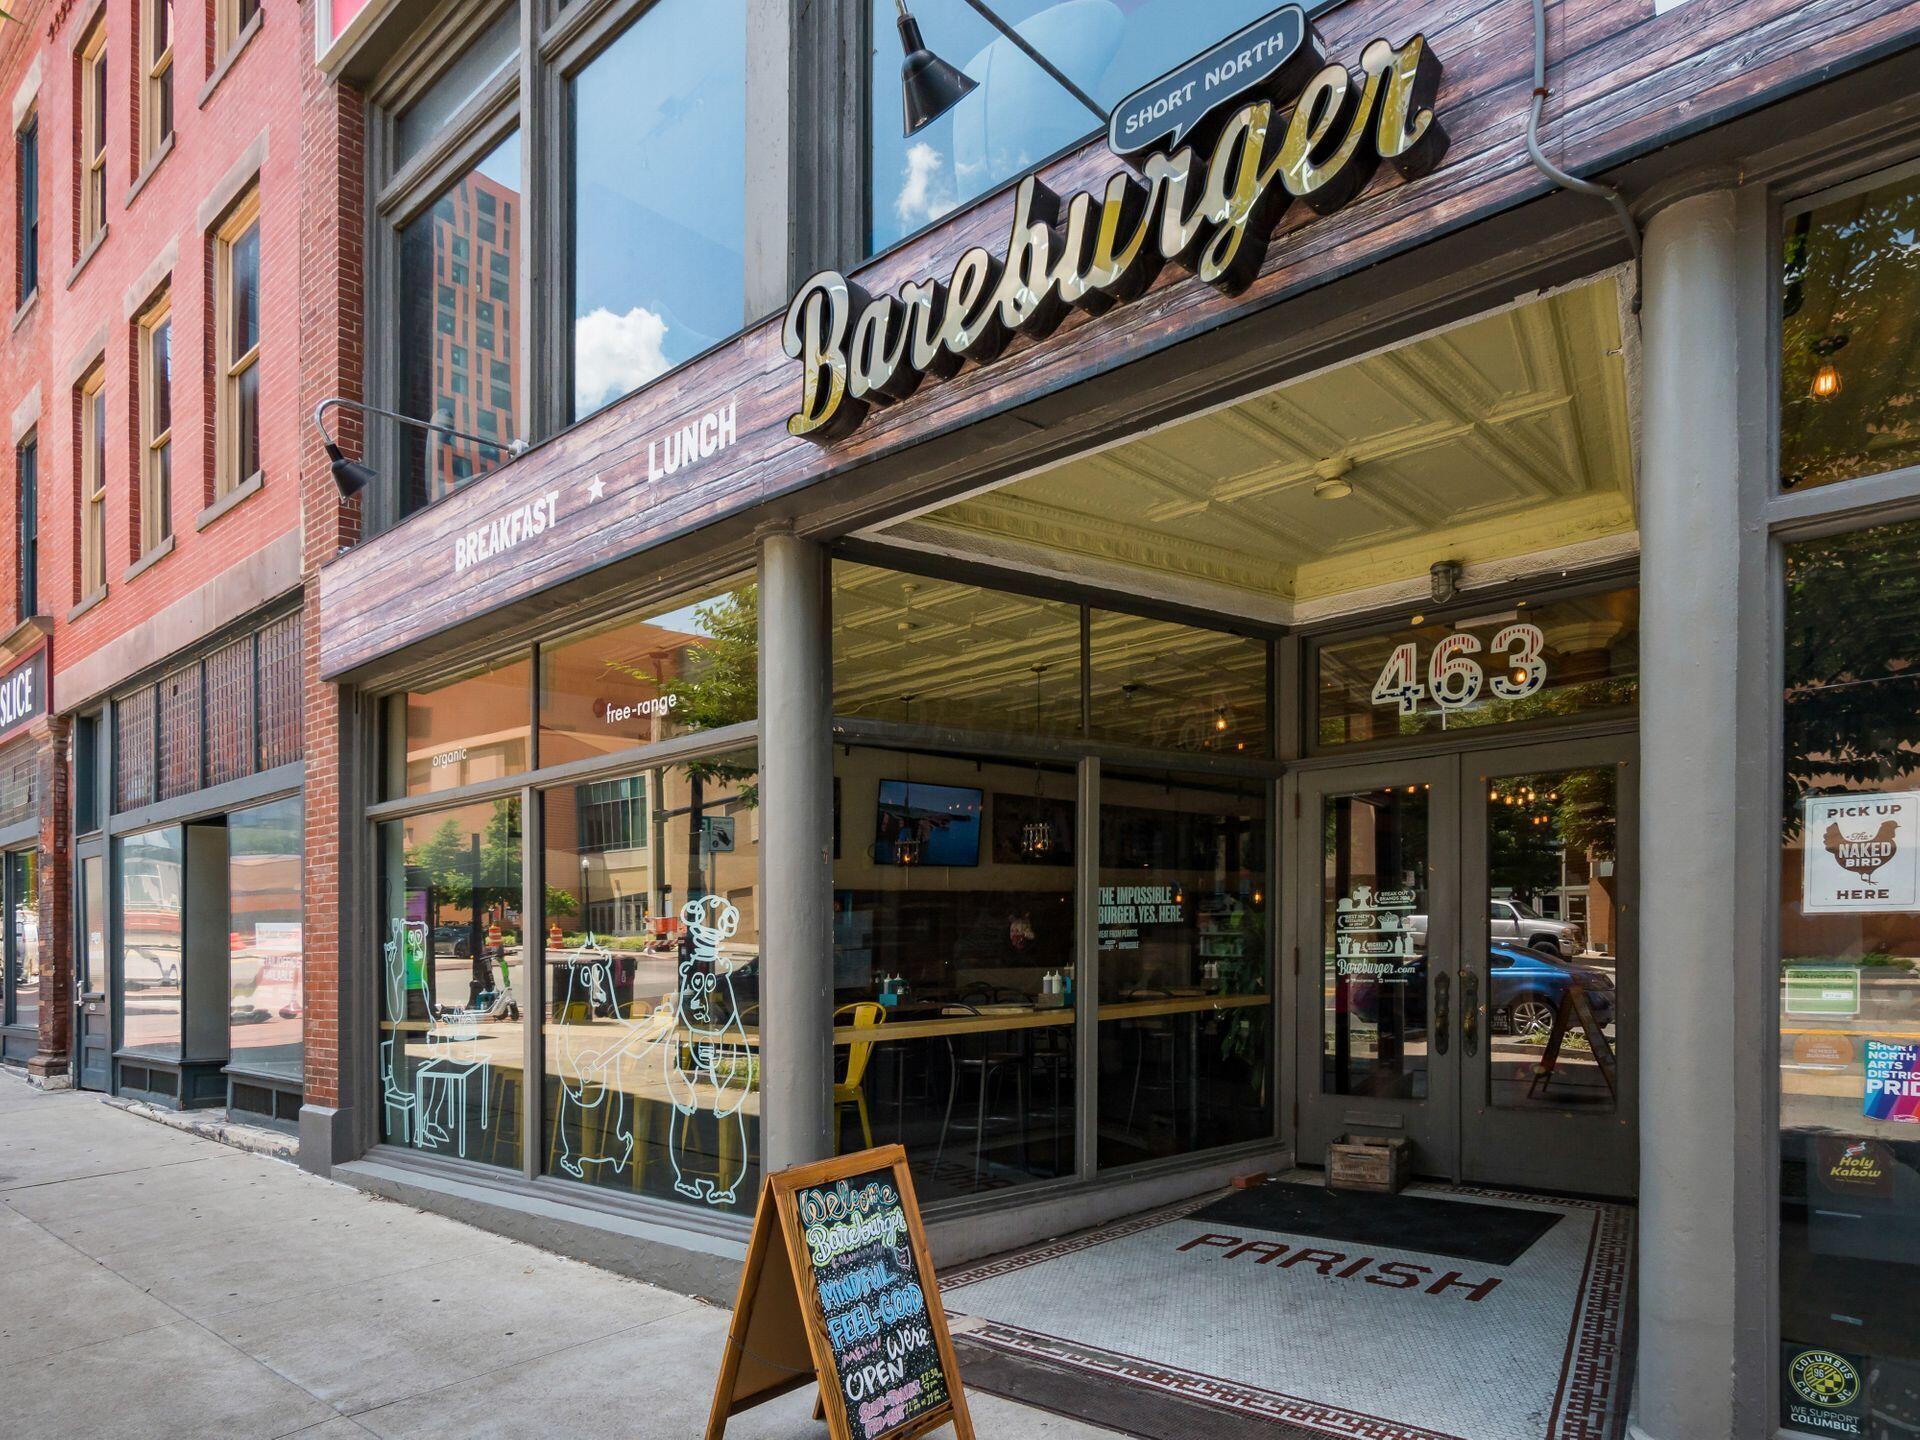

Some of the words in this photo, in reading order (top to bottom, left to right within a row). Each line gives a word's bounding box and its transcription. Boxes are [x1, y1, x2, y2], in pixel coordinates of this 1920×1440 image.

[1125, 80, 1197, 134] SHORT
[1204, 31, 1284, 91] NORTH
[782, 33, 1436, 438] Bareburger
[455, 490, 559, 573] BREAKFAST
[648, 402, 738, 483] LUNCH
[1371, 623, 1547, 715] 463
[0, 667, 33, 728] SLICE
[606, 693, 677, 724] free-range
[432, 745, 467, 768] organic
[1827, 806, 1870, 819] PICK
[1876, 804, 1902, 816] UP
[1839, 841, 1892, 859] NAKED
[1845, 857, 1882, 868] BIRD
[1098, 886, 1115, 905] THE
[1116, 886, 1172, 904] IMPOSSIBLE
[1837, 889, 1890, 900] HERE
[1138, 905, 1158, 923] YES.
[1158, 904, 1184, 923] HERE.
[1868, 1051, 1917, 1061] NORTH
[1868, 1060, 1904, 1070] ARTS
[1830, 1166, 1882, 1178] Kakow
[1839, 1156, 1875, 1169] Holy
[799, 1180, 898, 1226] Welcome
[1176, 1233, 1503, 1302] PARISH
[819, 1260, 897, 1310] MINDFUL
[827, 1283, 924, 1351] FEEL-GOOD
[1795, 1354, 1853, 1380] COLUMBUS
[1813, 1368, 1825, 1379] 96
[845, 1357, 904, 1401] OPEN
[1796, 1381, 1829, 1403] CREW
[1837, 1388, 1852, 1401] SC
[1790, 1404, 1807, 1416] WE
[1809, 1408, 1860, 1425] SUPPORT
